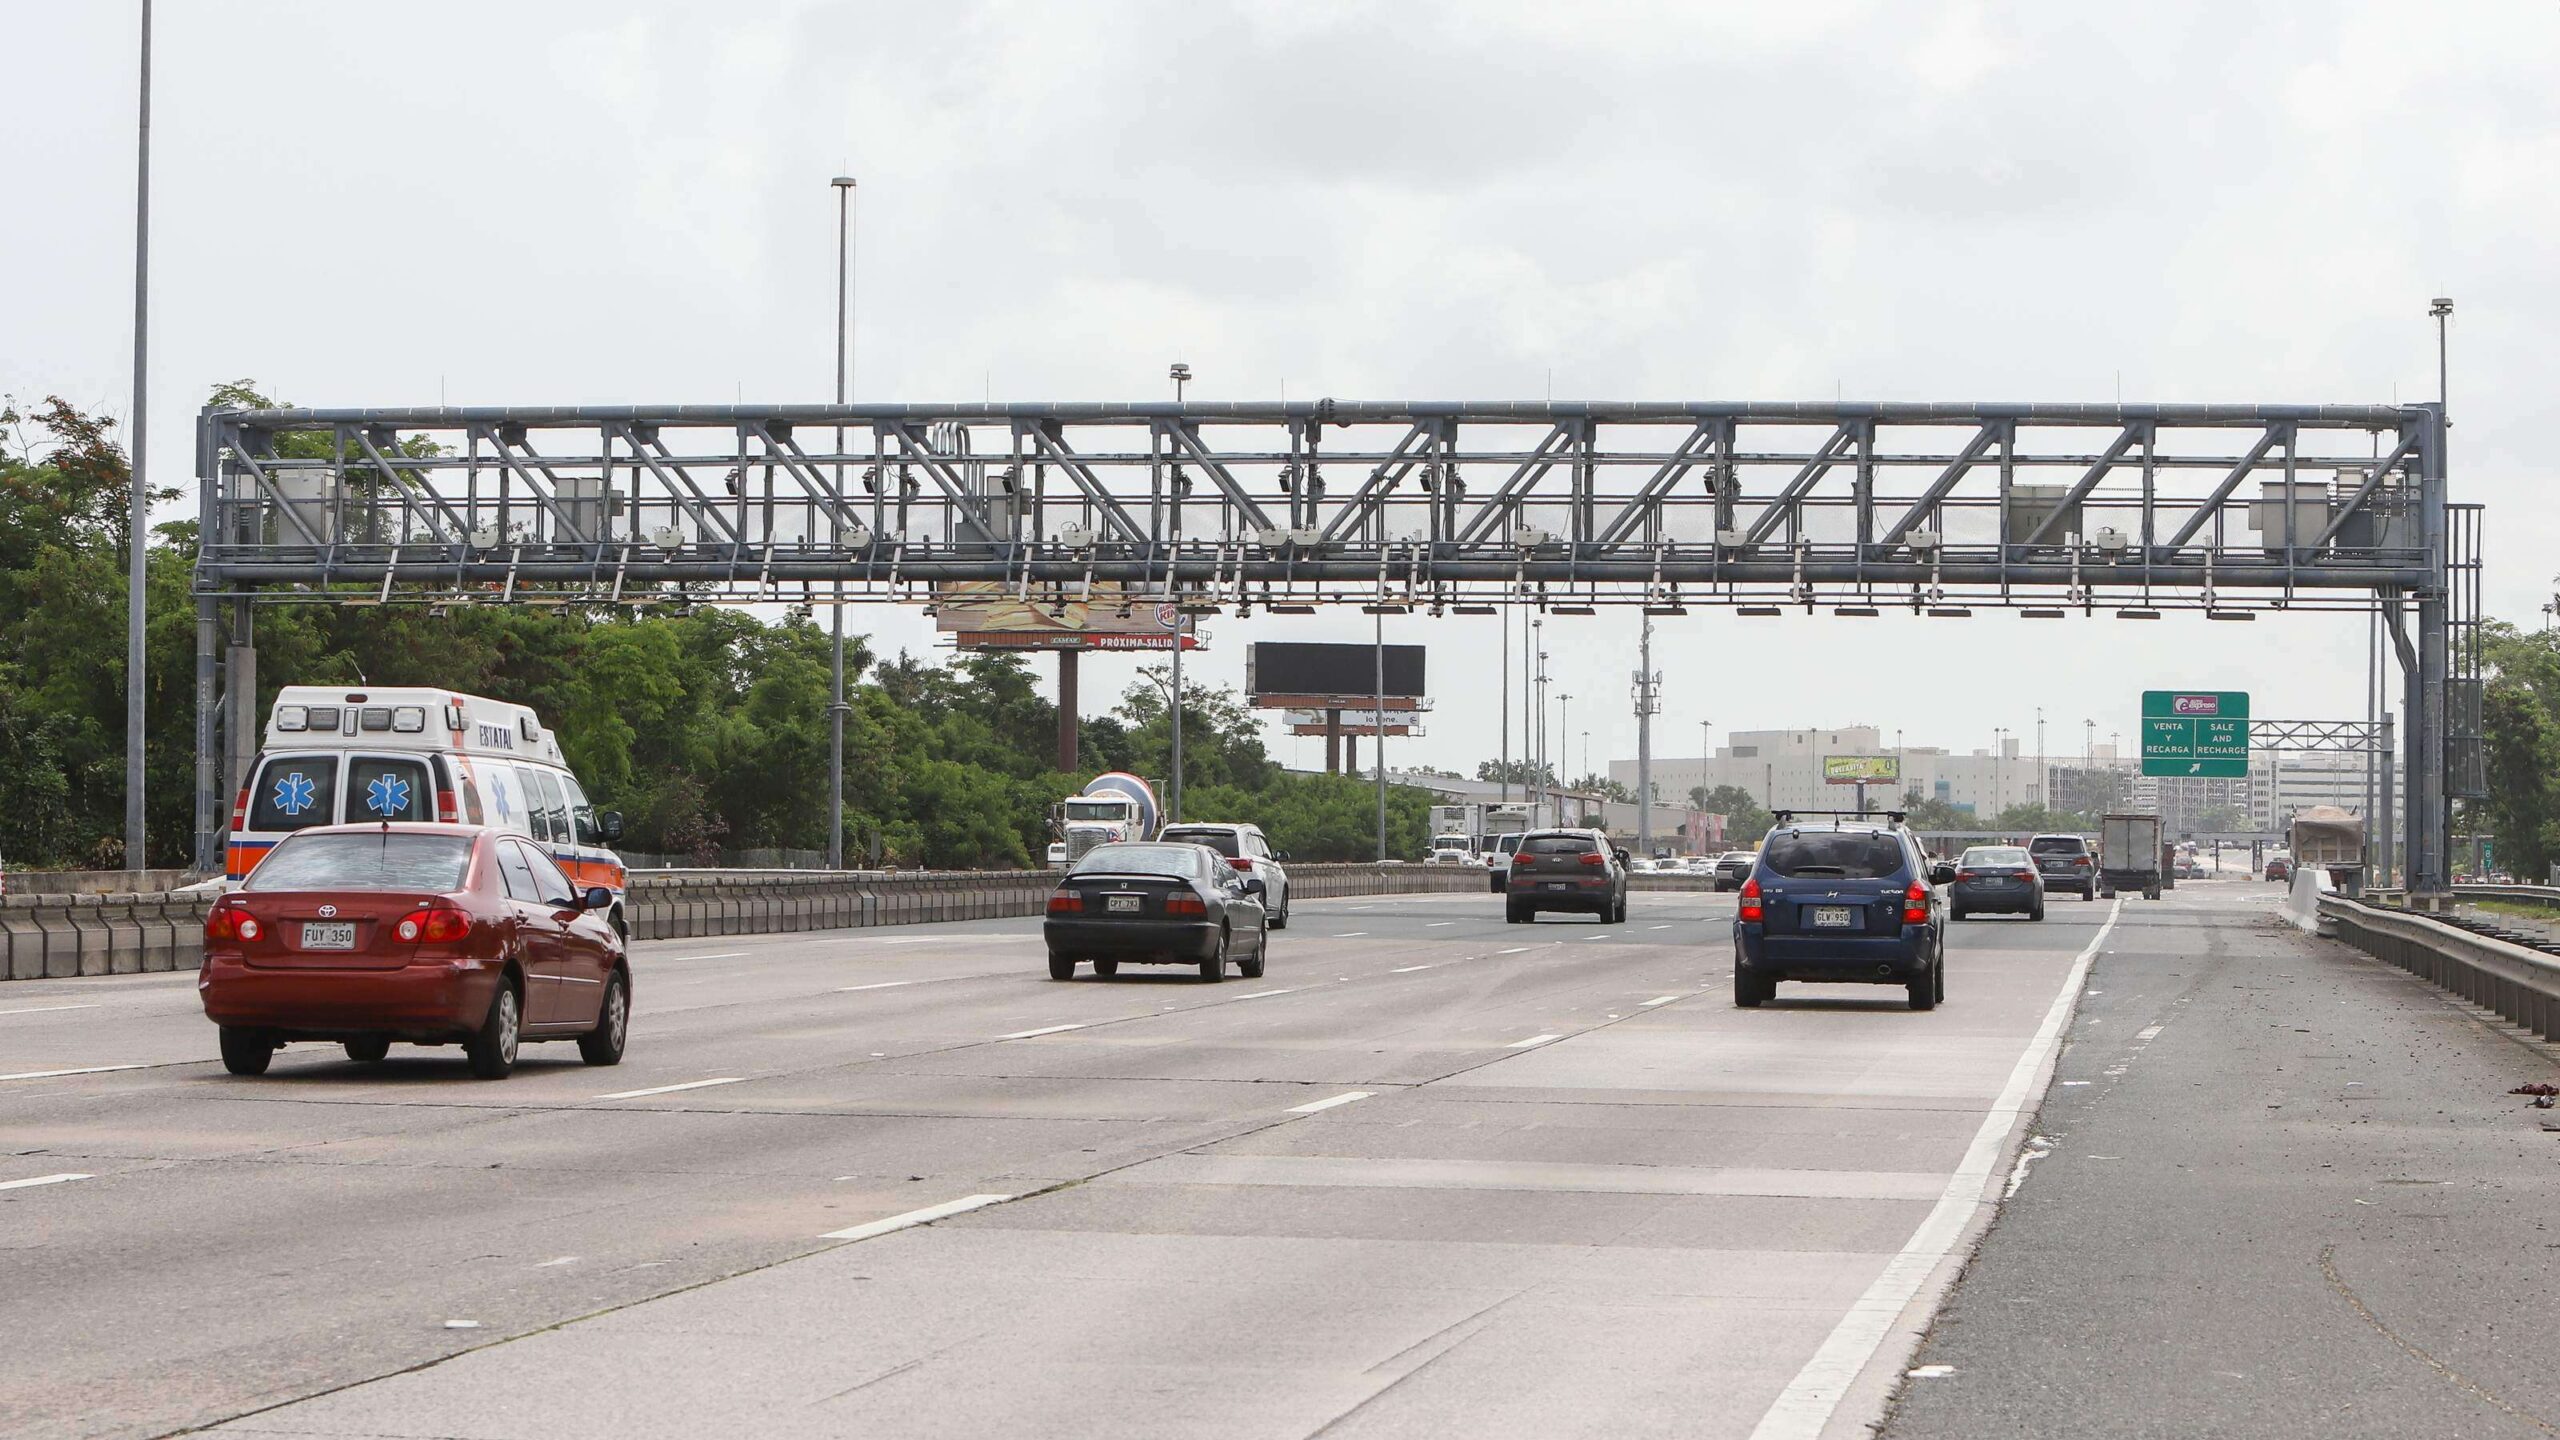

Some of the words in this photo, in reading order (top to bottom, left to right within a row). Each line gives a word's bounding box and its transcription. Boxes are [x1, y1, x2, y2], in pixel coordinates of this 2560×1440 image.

[1159, 610, 1175, 620] KIN
[1100, 637, 1144, 648] PRÓXIMA
[1147, 638, 1175, 648] SALID
[2153, 722, 2184, 730] VENTA
[2210, 723, 2235, 731] SALE
[479, 725, 513, 750] ESTATAL
[2165, 734, 2172, 742] Y
[2146, 745, 2190, 753] RECARGA
[2197, 746, 2247, 754] RECHARGE
[1834, 913, 1848, 921] 950
[304, 929, 325, 942] FUY
[331, 929, 352, 942] 350
